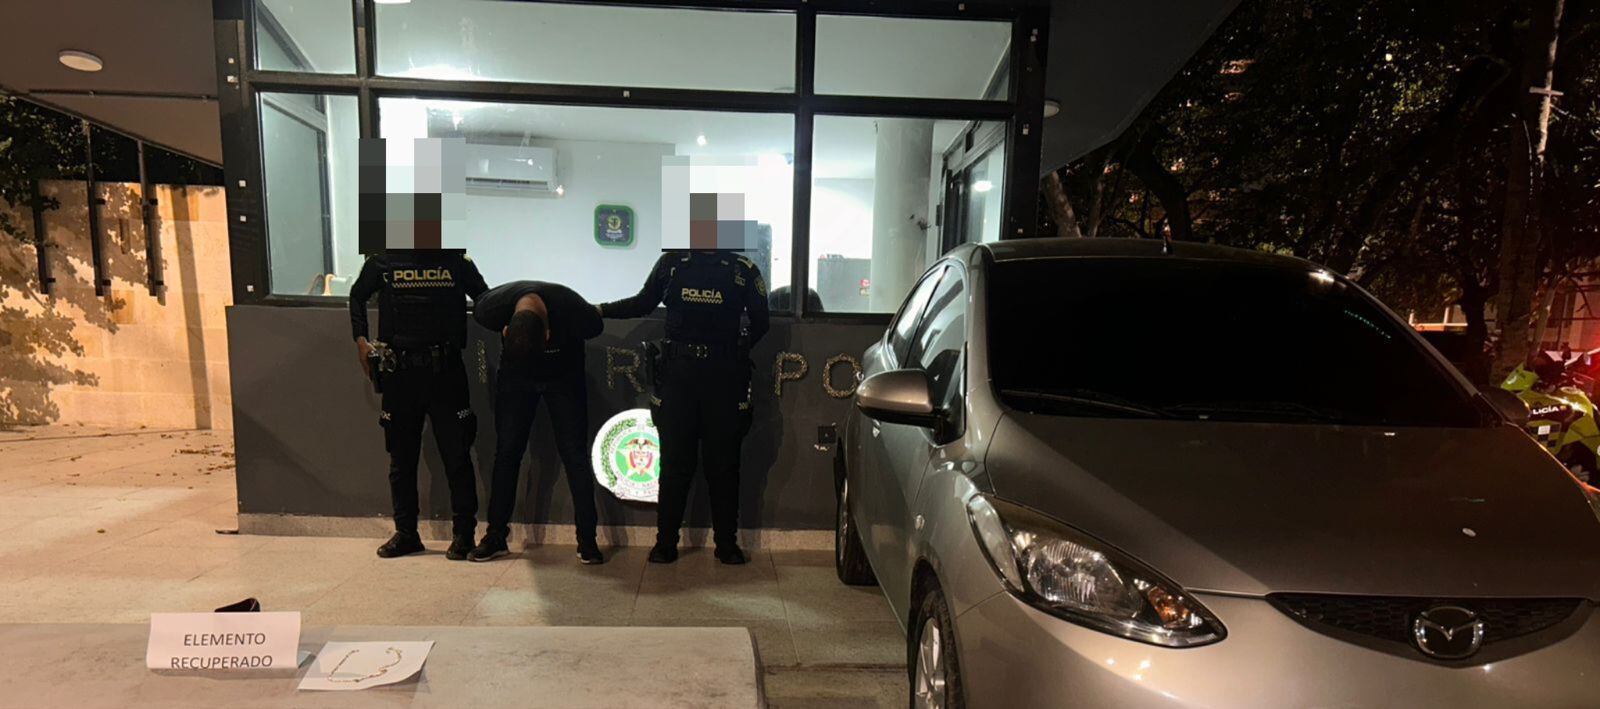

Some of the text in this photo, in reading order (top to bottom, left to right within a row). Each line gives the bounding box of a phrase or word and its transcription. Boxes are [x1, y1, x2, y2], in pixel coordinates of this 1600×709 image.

[393, 266, 453, 281] POLICÍA
[681, 287, 722, 299] POLICÍA
[1532, 405, 1559, 415] LICÍA
[183, 632, 266, 647] ELEMENTO
[170, 654, 273, 670] RECUPERADO
